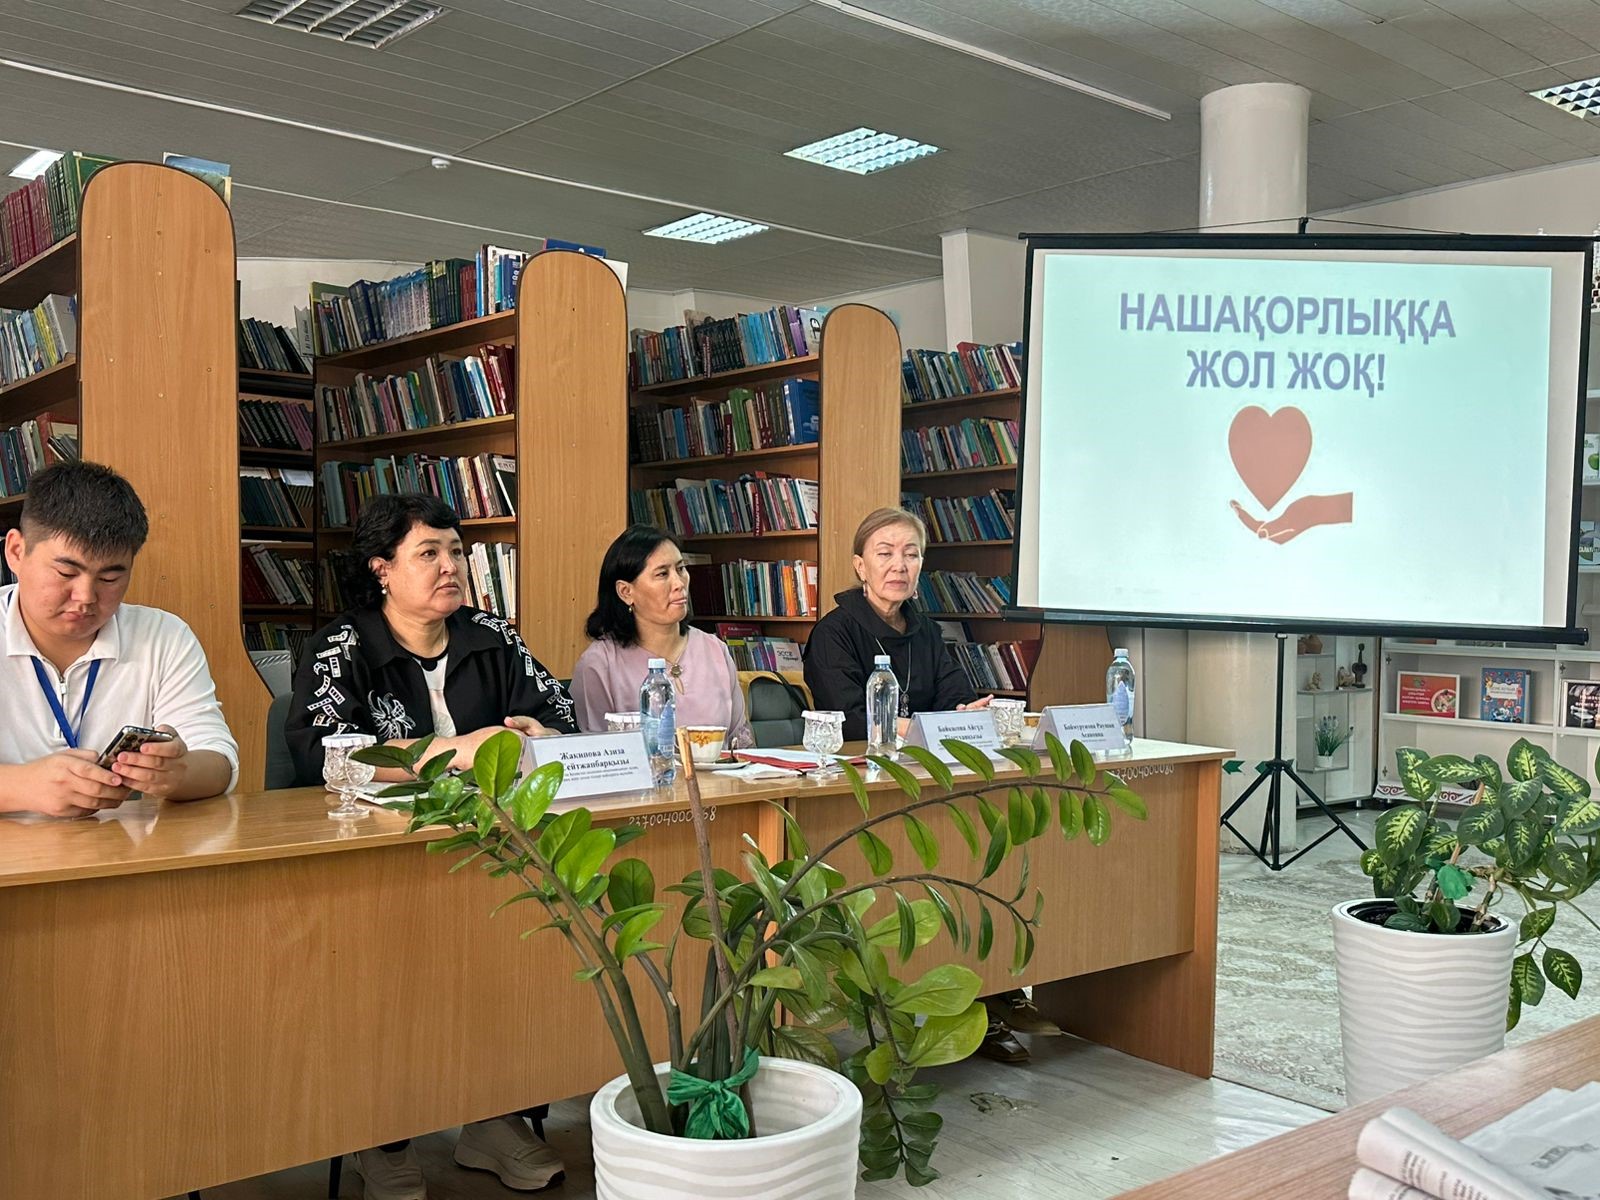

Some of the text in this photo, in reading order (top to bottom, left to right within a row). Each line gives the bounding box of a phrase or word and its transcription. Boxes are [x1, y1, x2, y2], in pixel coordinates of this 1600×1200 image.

[1119, 292, 1456, 345] НАШАҚОРЛЫҚҚА
[1186, 350, 1385, 398] ЖОЛ ЖОҚ!
[603, 747, 625, 757] Азиза
